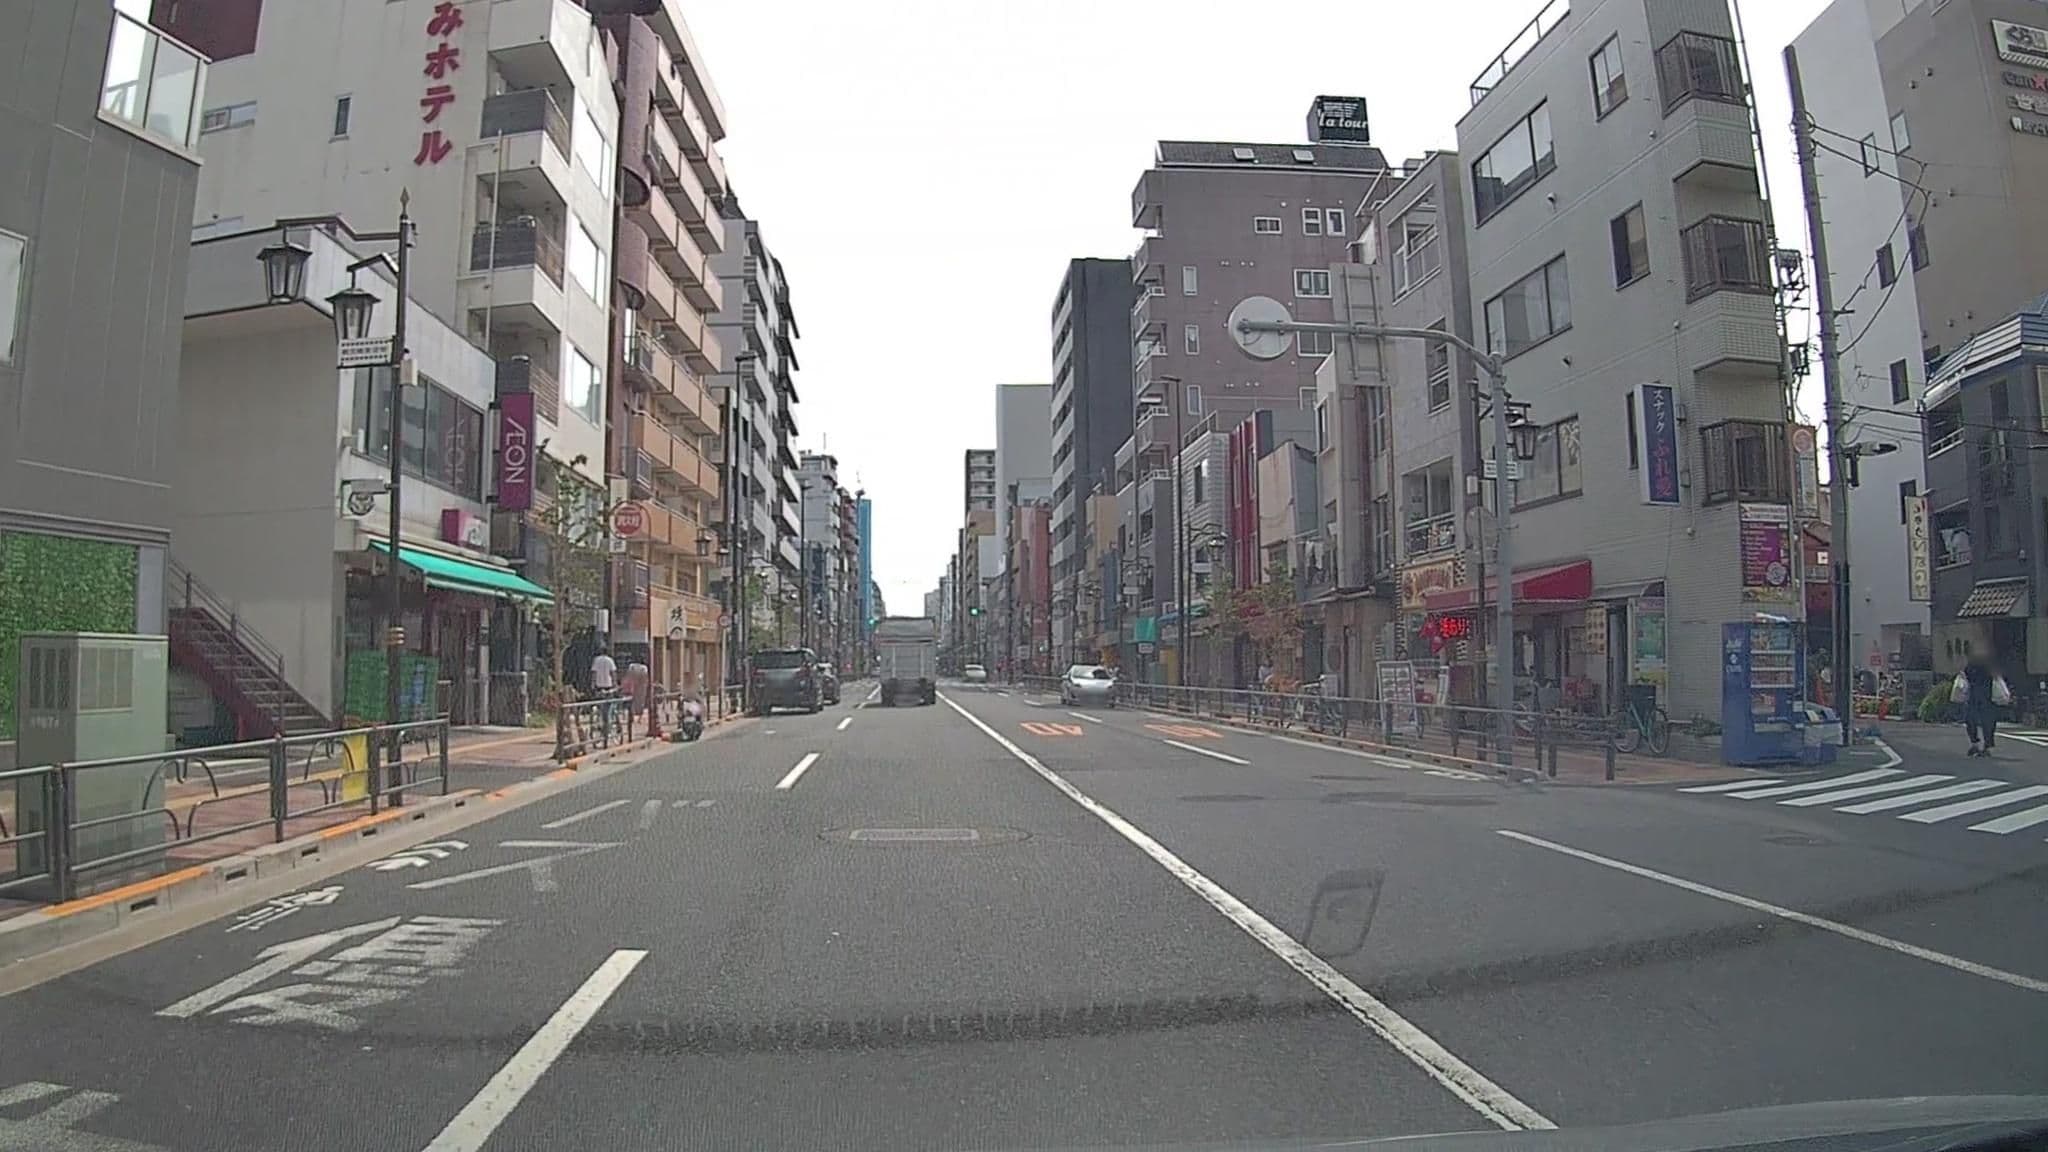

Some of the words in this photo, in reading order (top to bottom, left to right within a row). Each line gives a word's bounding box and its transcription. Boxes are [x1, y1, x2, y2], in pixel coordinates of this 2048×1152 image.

[413, 1, 464, 167] みホテル
[1339, 117, 1368, 129] tour
[1652, 390, 1665, 433] スナック
